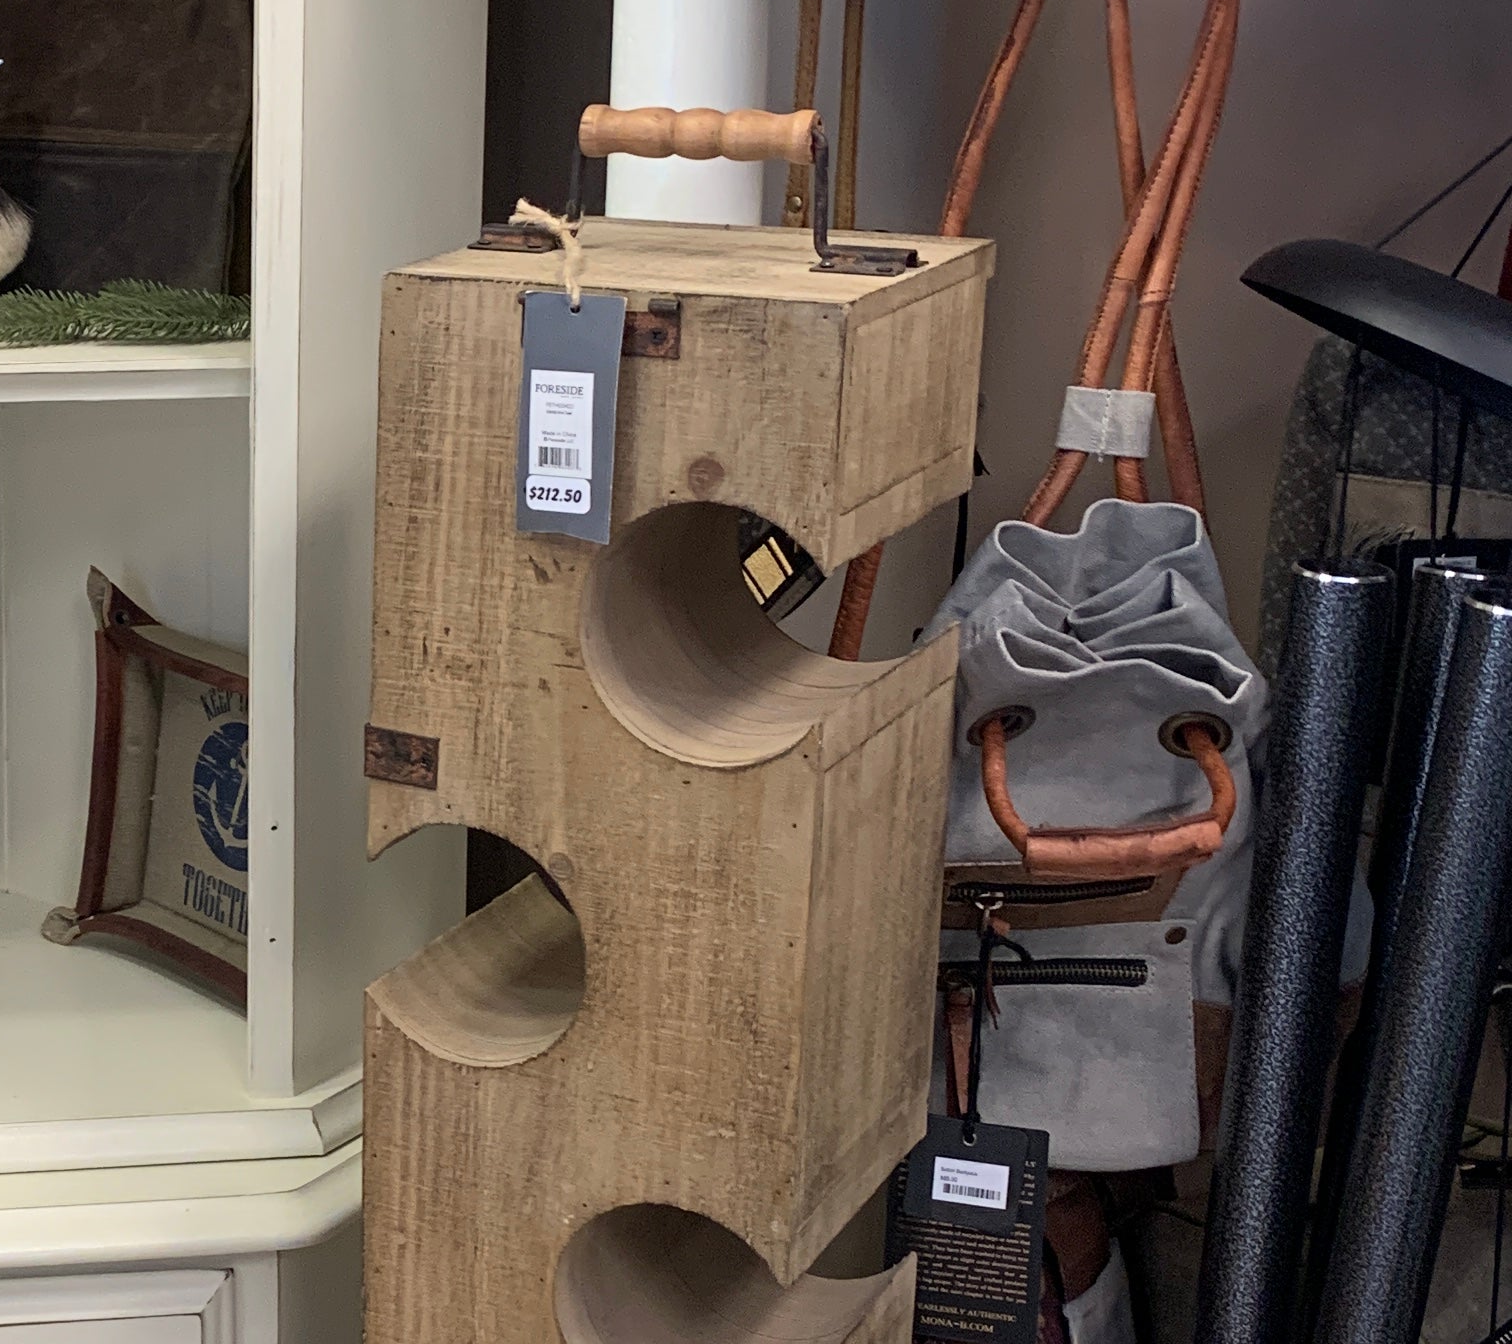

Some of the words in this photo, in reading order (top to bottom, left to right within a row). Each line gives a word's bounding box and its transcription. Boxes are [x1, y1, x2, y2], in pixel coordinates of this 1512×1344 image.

[535, 383, 584, 396] FORESIDE
[528, 485, 583, 504] $212.50
[200, 687, 232, 722] KEEP
[917, 1302, 966, 1315] EARLESSLY
[967, 1309, 1018, 1323] AUTHENTIC
[920, 1314, 994, 1334] MONA-B.COM
